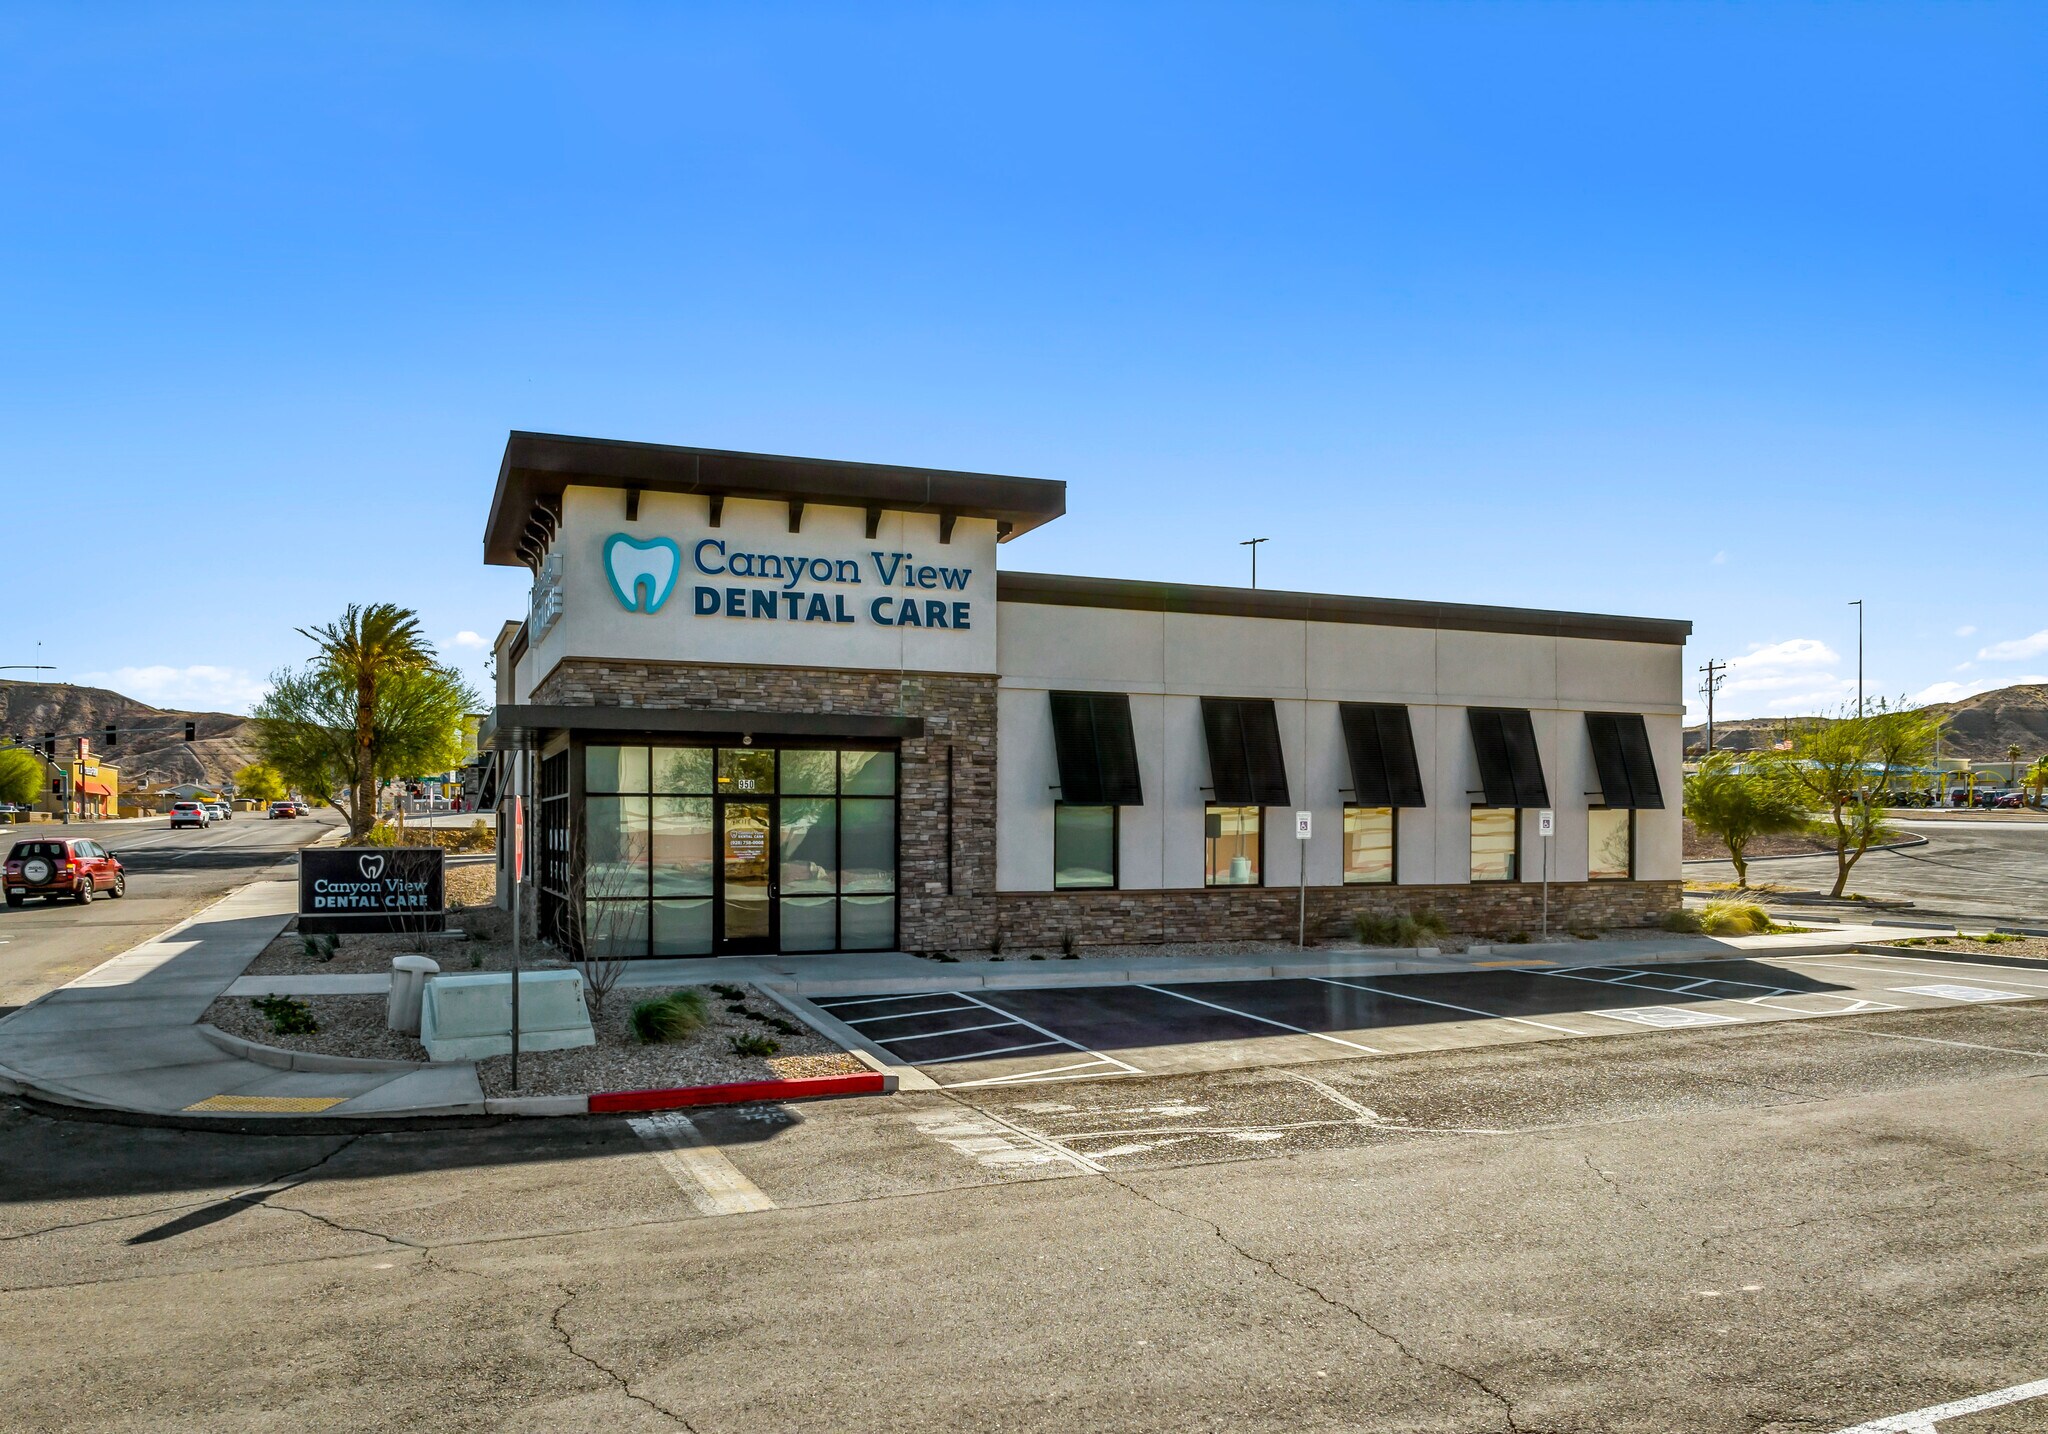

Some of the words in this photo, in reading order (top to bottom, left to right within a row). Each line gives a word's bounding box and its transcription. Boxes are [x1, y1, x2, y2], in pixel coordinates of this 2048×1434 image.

[694, 538, 862, 590] Canyon
[870, 551, 972, 591] View
[694, 586, 855, 623] DENTAL
[870, 596, 971, 630] CARE
[739, 780, 754, 789] 950
[314, 879, 382, 896] Canyon
[385, 878, 429, 892] View
[314, 895, 379, 908] DENTAL
[385, 895, 428, 907] CARE
